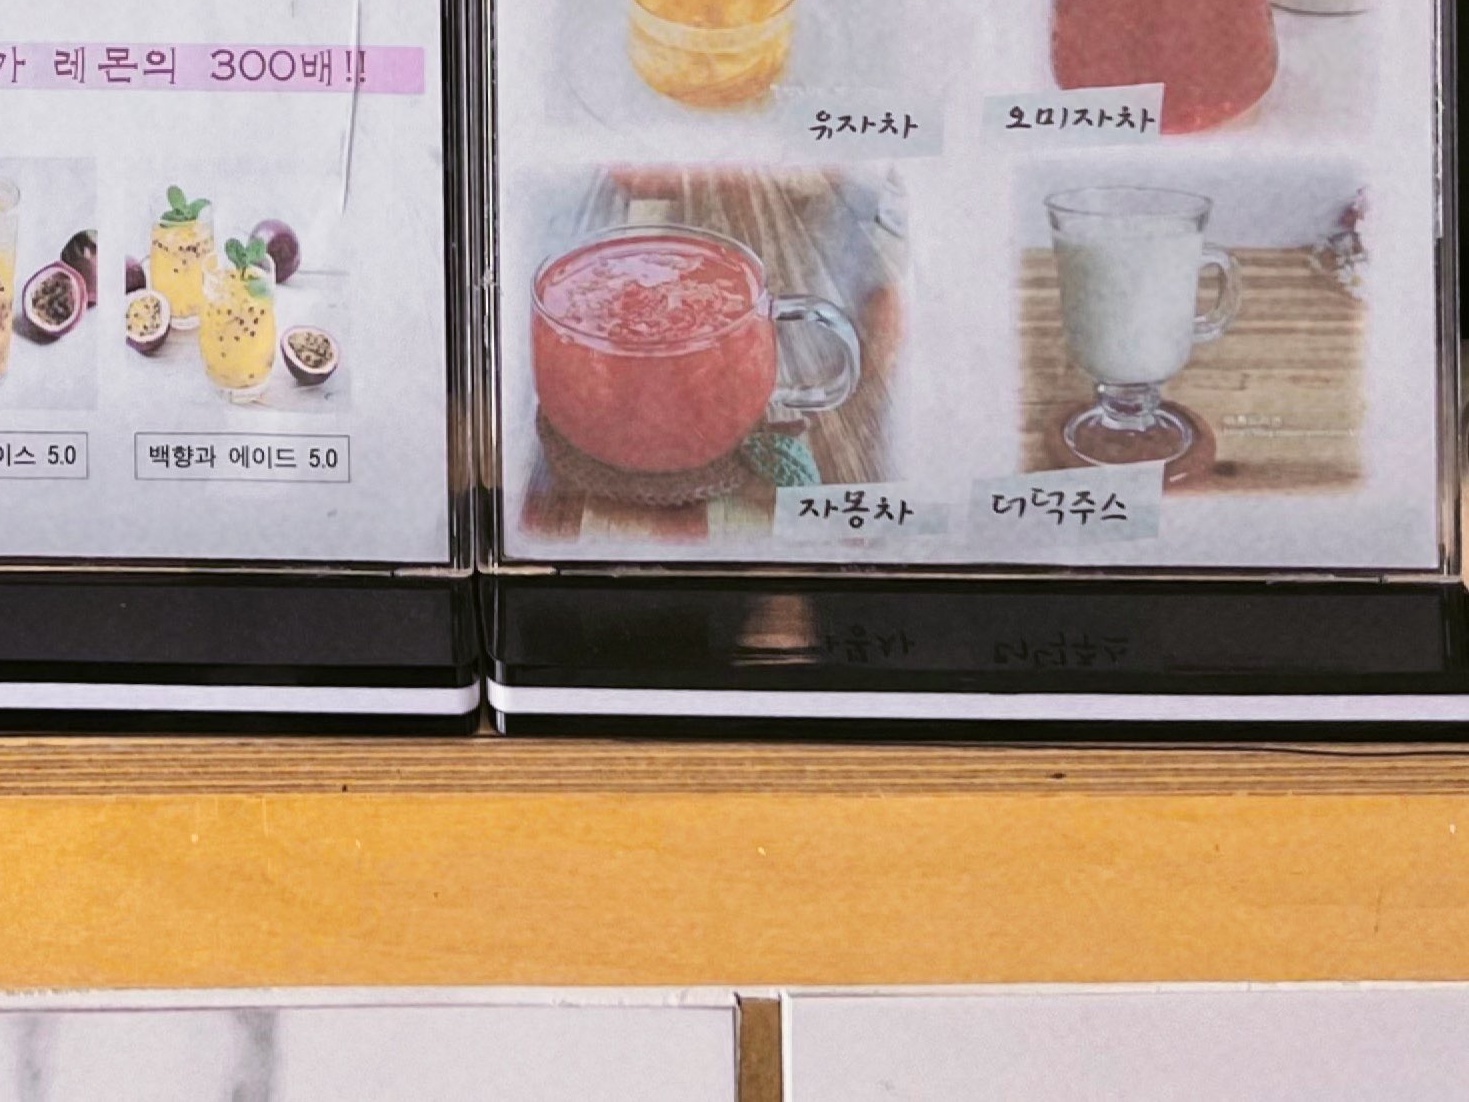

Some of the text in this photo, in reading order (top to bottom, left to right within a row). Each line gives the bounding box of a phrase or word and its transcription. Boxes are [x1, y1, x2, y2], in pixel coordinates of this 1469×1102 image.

[53, 46, 177, 85] 레몬의
[210, 47, 367, 86] 300배!!
[809, 110, 919, 141] 유자차
[1006, 105, 1157, 134] 오미자차
[48, 444, 76, 466] 5.0
[149, 445, 338, 469] 백향과 에이드 5.0
[799, 490, 914, 529] 자몽차
[992, 487, 1129, 525] 더덕주스
